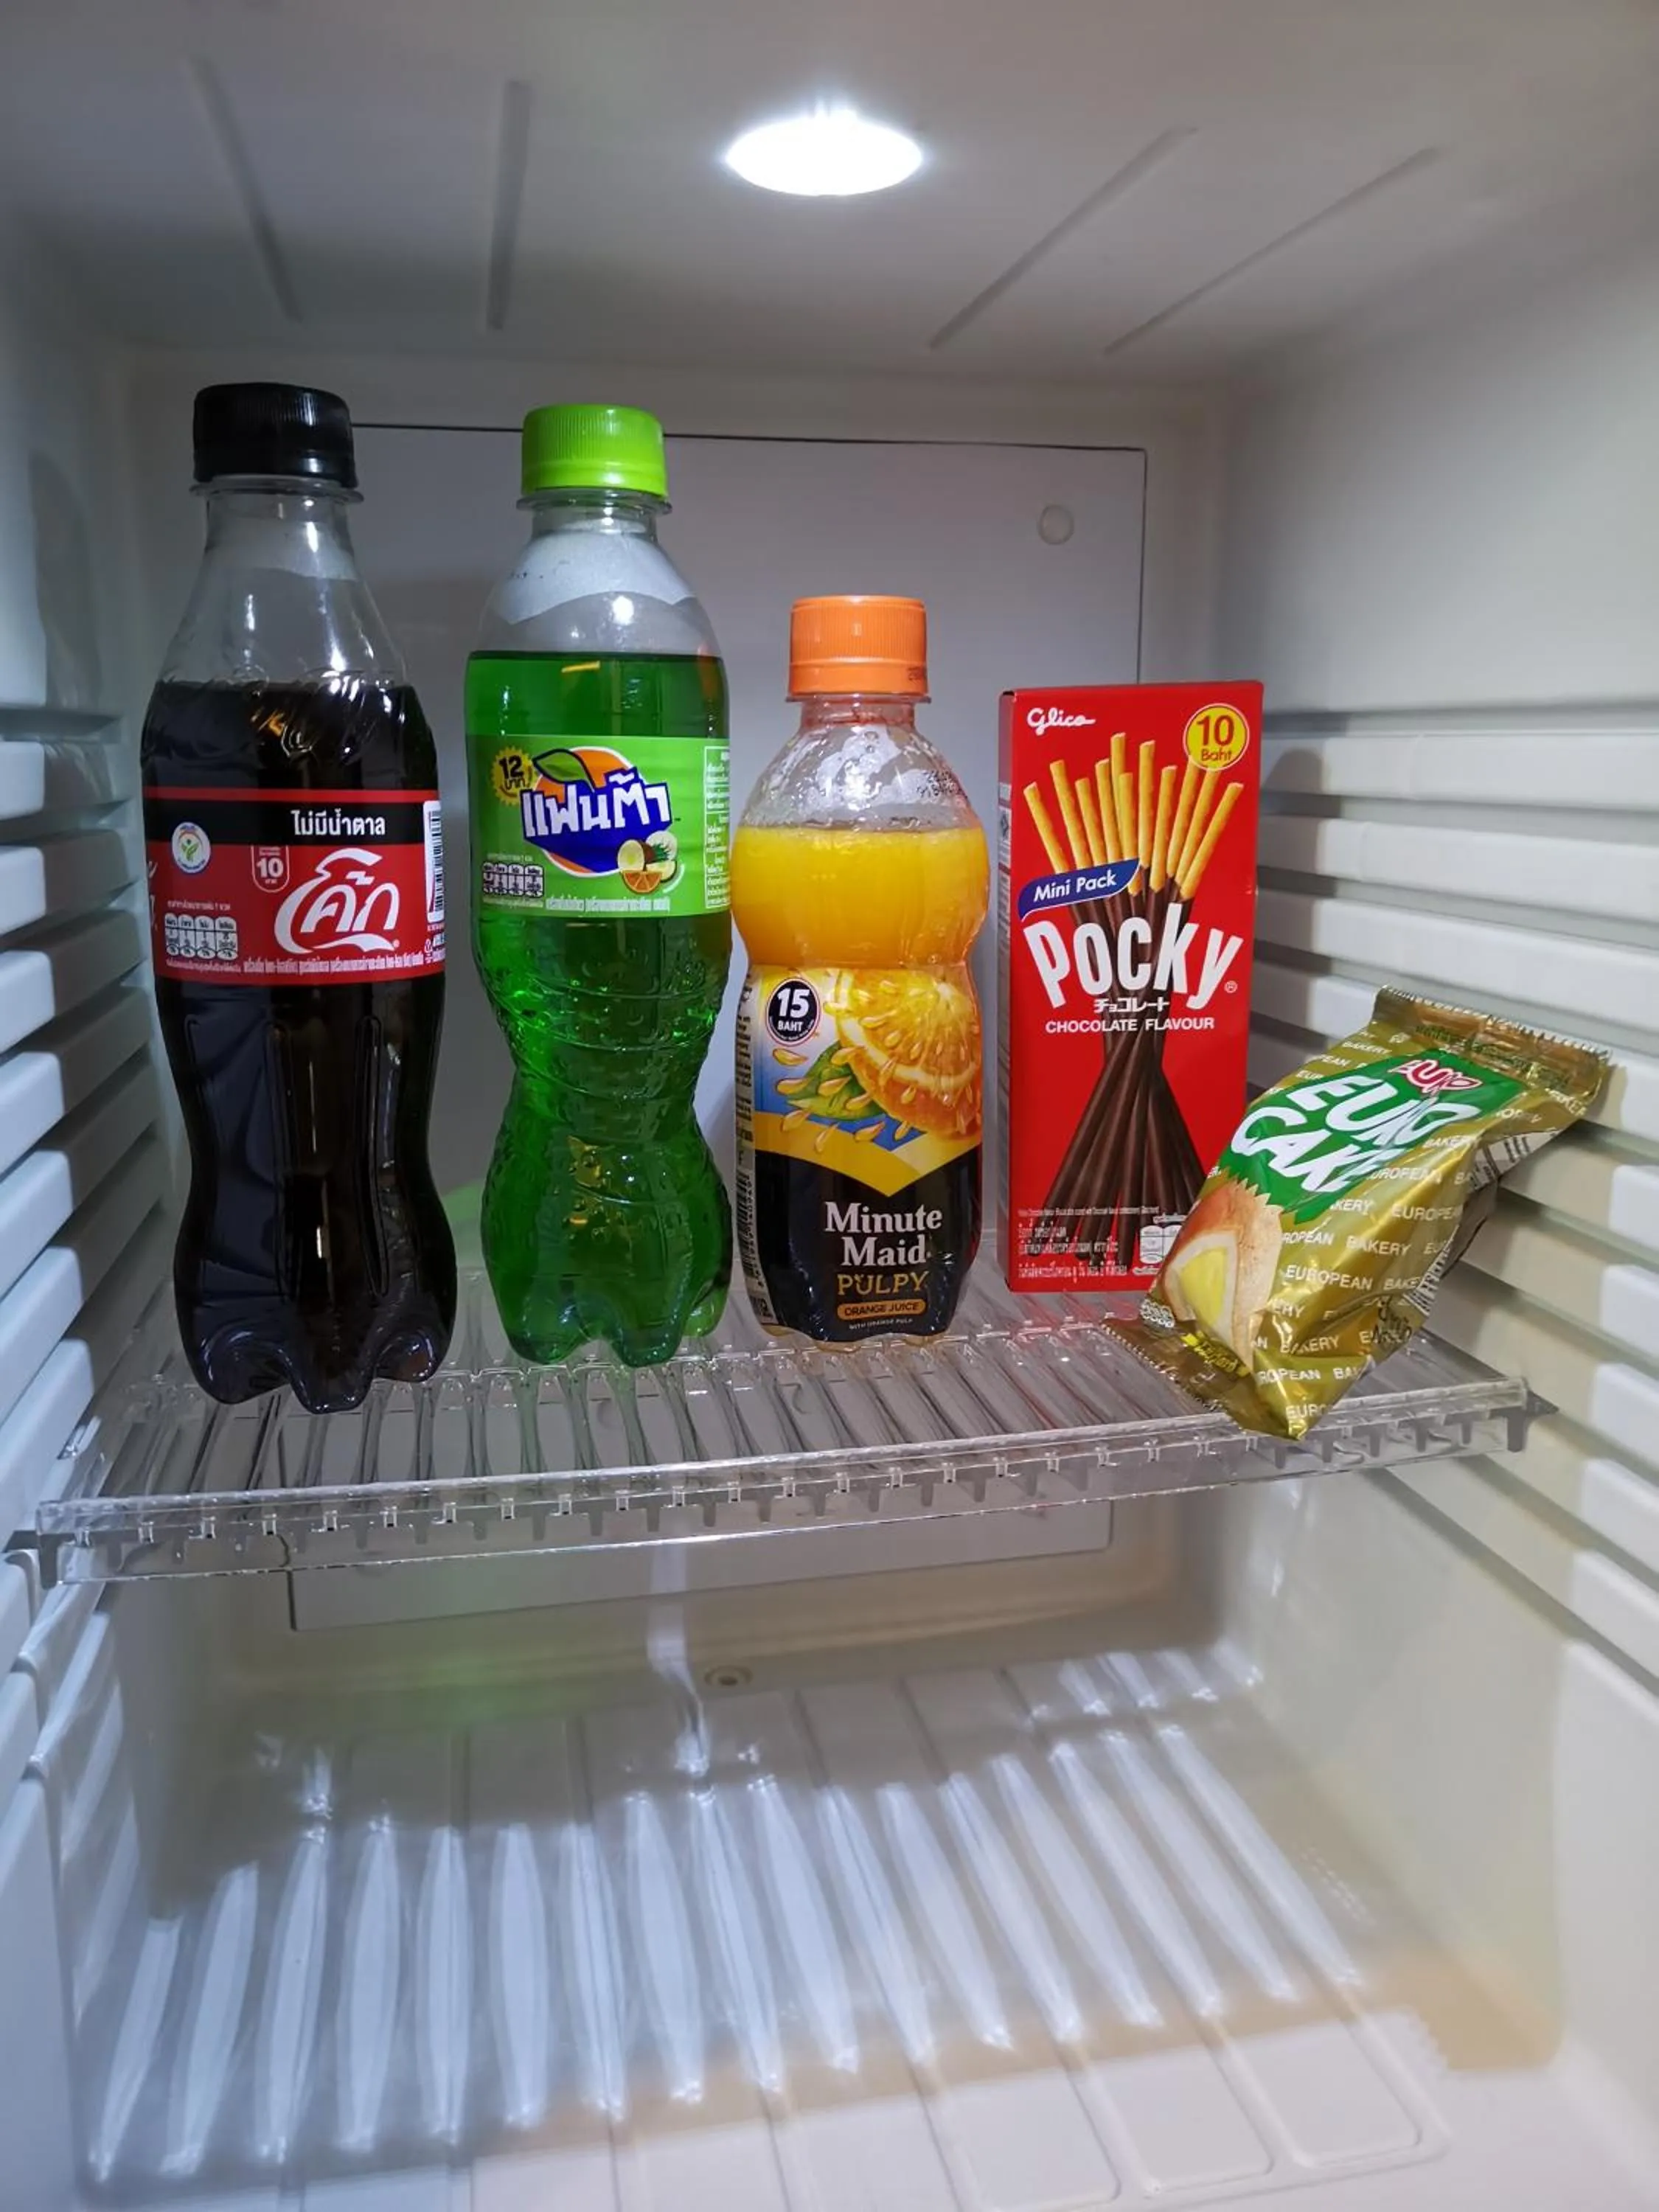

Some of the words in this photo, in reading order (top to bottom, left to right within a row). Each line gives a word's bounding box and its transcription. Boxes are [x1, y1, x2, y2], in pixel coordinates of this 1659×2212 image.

[1027, 707, 1096, 736] Glico
[1197, 714, 1234, 746] 10
[499, 756, 524, 779] 12
[1201, 748, 1232, 762] Baht
[522, 773, 670, 837] แฟนต้า
[291, 809, 386, 836] ไม่มีน้ำตาล
[257, 858, 284, 878] 10
[1034, 877, 1071, 902] Mini
[1075, 871, 1116, 893] Pack
[776, 987, 810, 1018] 15
[1093, 998, 1169, 1013] チョコレート
[777, 1020, 804, 1032] BAHT
[1046, 1018, 1138, 1032] CHOCOLATE
[1145, 1017, 1214, 1030] FLAVOUR
[824, 1201, 943, 1234] Minute
[841, 1234, 927, 1266] Maid
[1281, 1231, 1335, 1245] ROPEAN
[1346, 1236, 1411, 1256] BAKERY
[837, 1270, 929, 1295] PULPY
[1285, 1265, 1373, 1290] EUROPEAN
[844, 1306, 886, 1317] ORANGE
[889, 1301, 921, 1312] JUICE
